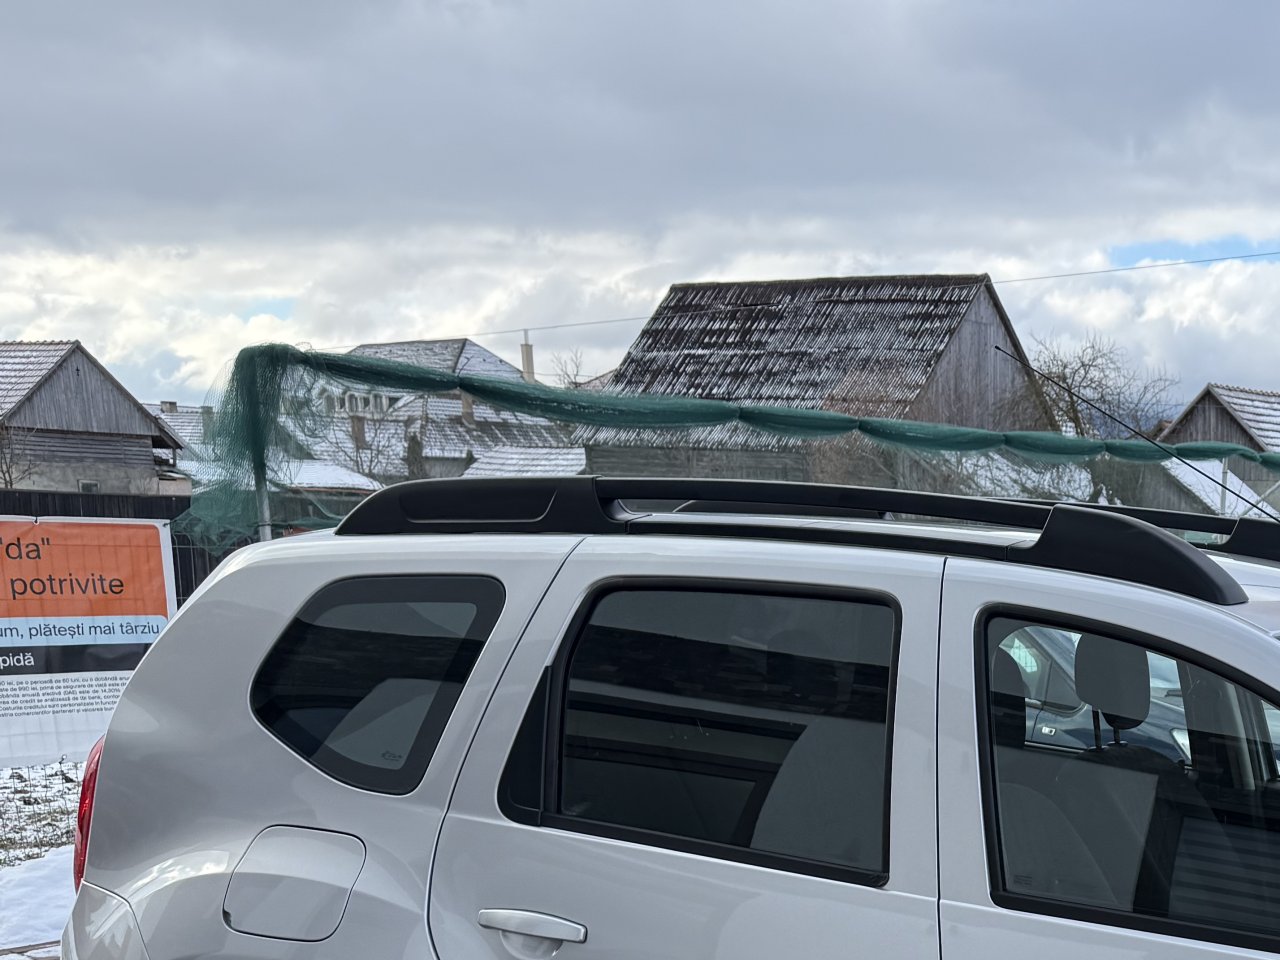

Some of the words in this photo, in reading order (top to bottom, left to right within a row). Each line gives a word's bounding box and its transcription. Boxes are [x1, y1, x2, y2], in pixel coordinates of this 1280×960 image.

[10, 573, 125, 600] potrivite
[28, 623, 85, 639] plătești
[89, 623, 115, 636] mai
[120, 622, 160, 636] târziu
